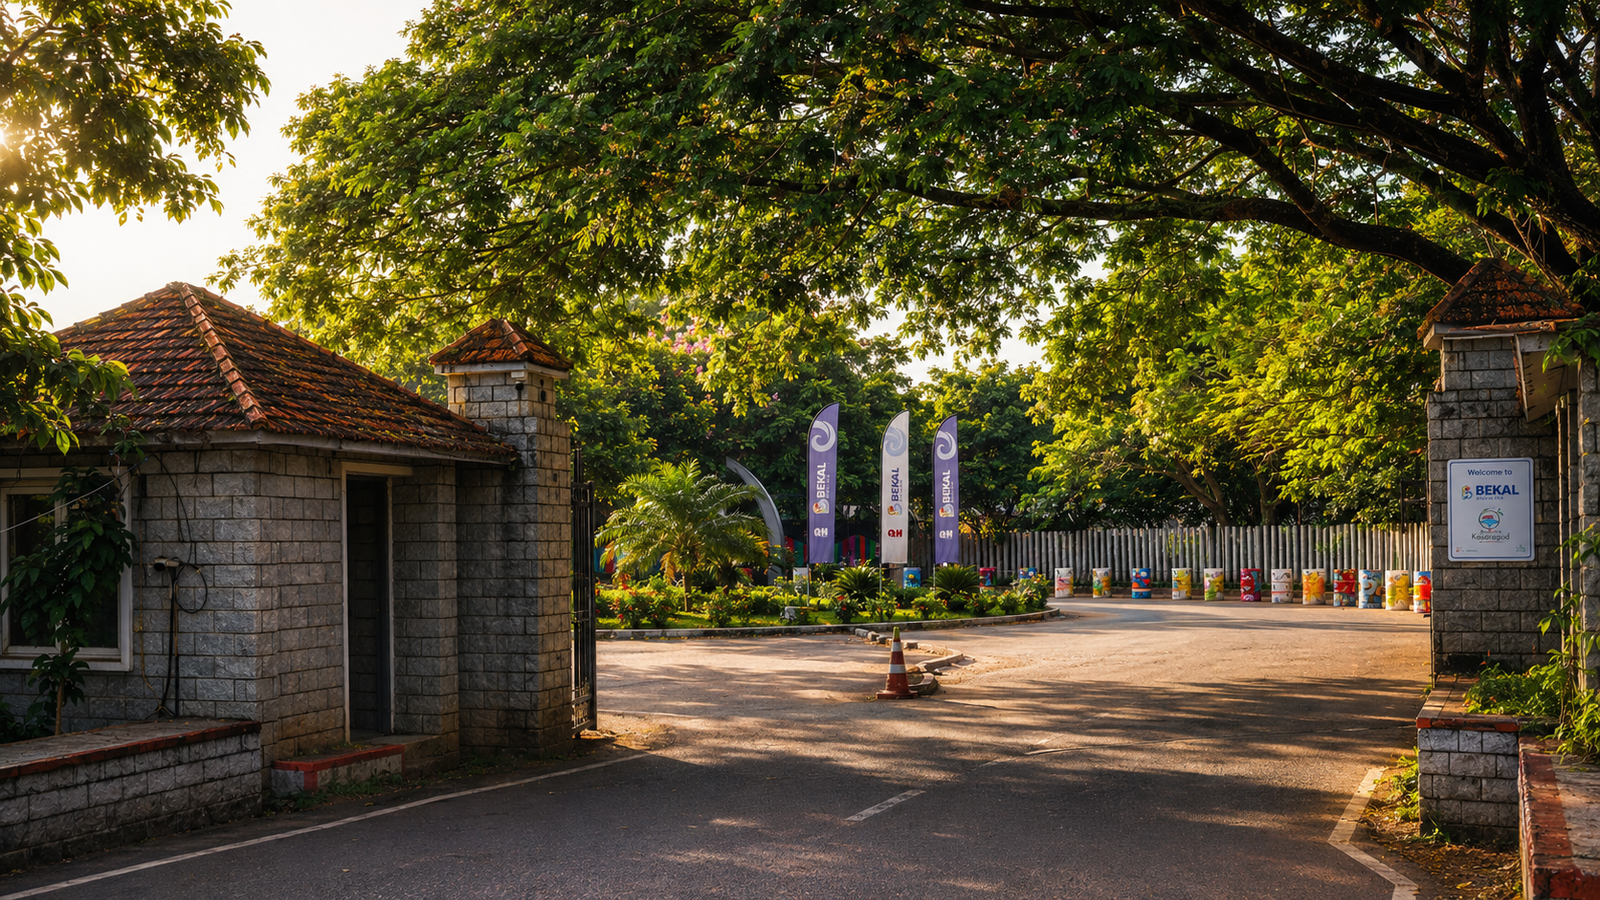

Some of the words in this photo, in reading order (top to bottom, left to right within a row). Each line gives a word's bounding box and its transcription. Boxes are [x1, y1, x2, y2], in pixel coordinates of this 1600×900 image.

[816, 462, 826, 498] BEKAL
[891, 467, 900, 502] BEKAL
[942, 469, 951, 503] BEKAL
[1475, 484, 1520, 495] BEKAL
[887, 529, 903, 538] QH
